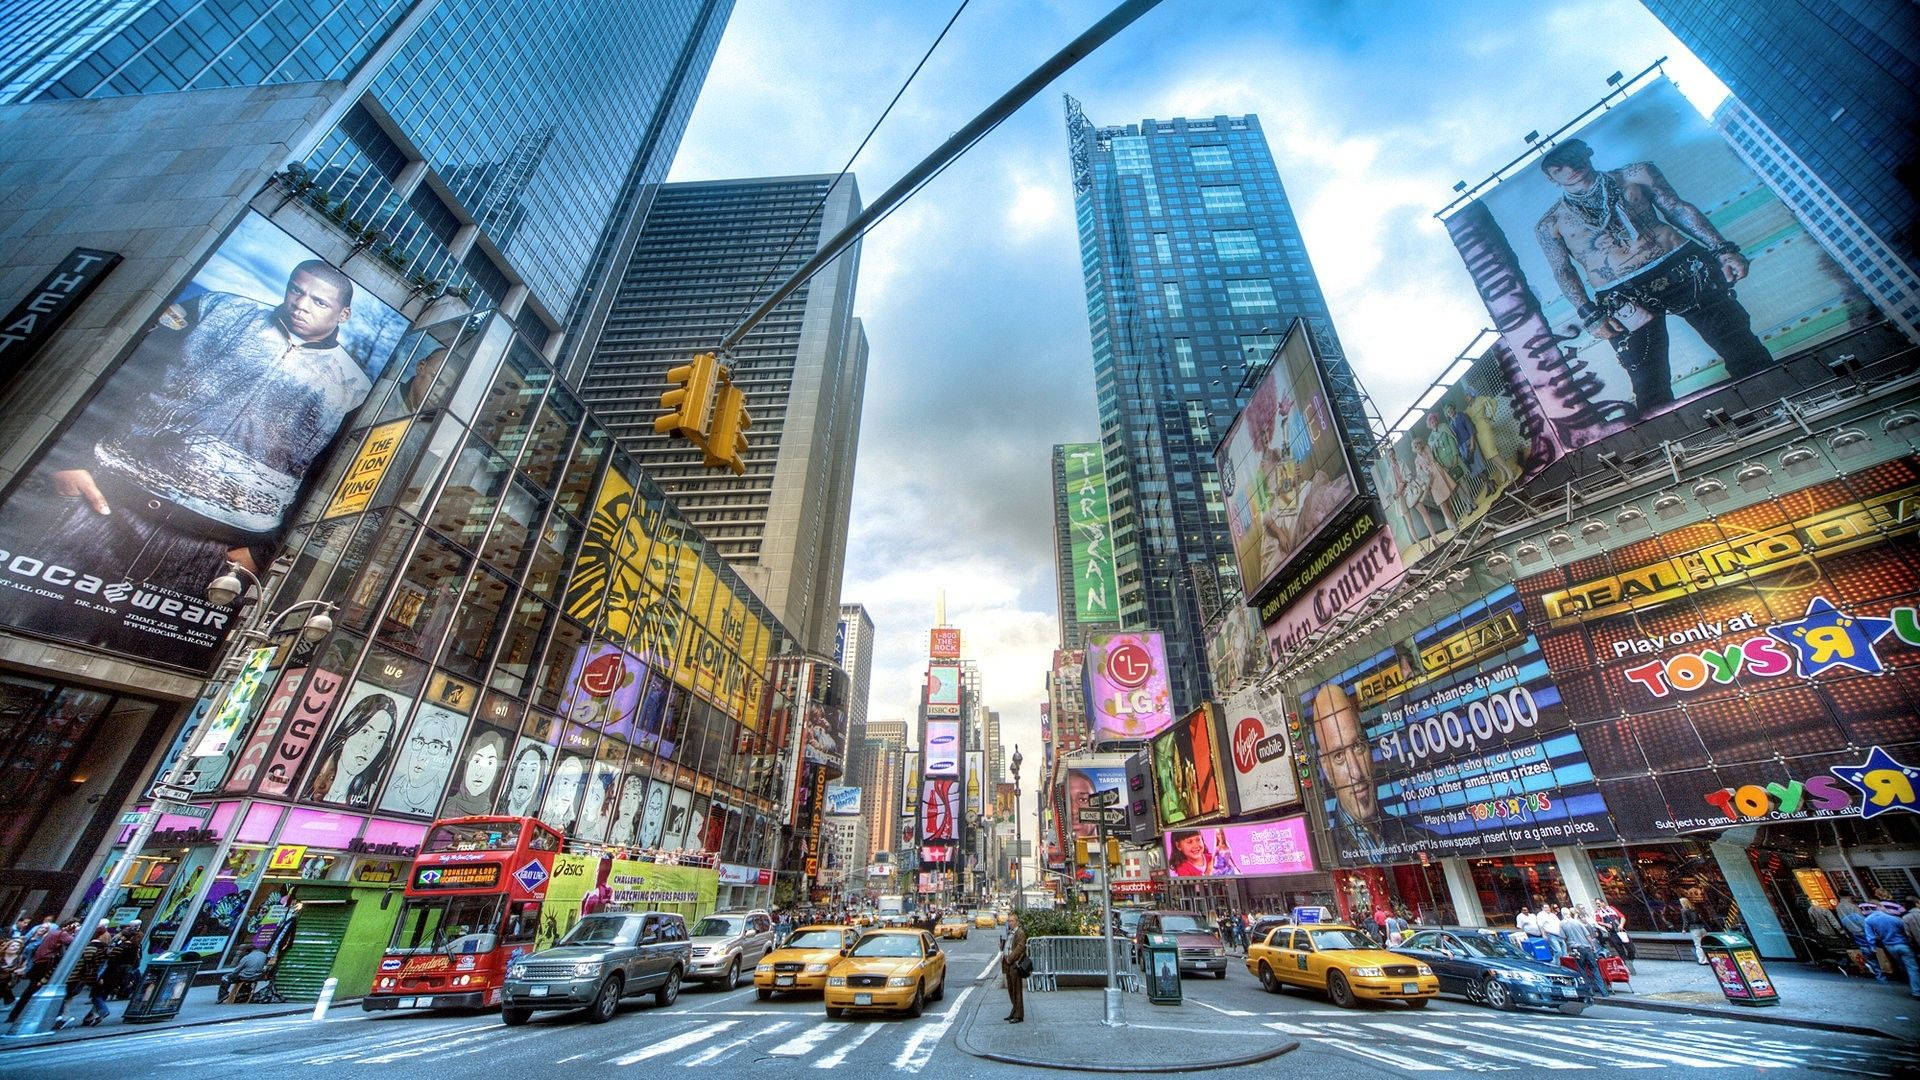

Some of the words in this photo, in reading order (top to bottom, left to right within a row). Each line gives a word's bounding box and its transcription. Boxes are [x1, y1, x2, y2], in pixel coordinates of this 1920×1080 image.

[370, 438, 393, 453] THE
[350, 455, 388, 480] LION
[335, 478, 375, 505] KING
[1261, 599, 1279, 621] BORN
[1279, 592, 1288, 604] IN
[1287, 580, 1302, 598] THE
[1301, 535, 1352, 585] GLAMOROUS
[1352, 514, 1374, 540] USA
[1554, 570, 1682, 619] DEAL
[1699, 534, 1803, 574] NO
[11, 582, 33, 593] ALL
[35, 587, 65, 601] ODDS
[142, 582, 157, 592] WE
[159, 587, 182, 599] RUN
[184, 594, 203, 605] THE
[203, 599, 234, 613] STRIP
[93, 604, 118, 615] JAYS
[123, 619, 214, 649] WWW.ROCAWEAR.COM
[125, 613, 156, 627] JIMMY
[156, 620, 180, 632] JAZZ
[186, 628, 218, 642] MACY'S
[1612, 634, 1665, 658] Play
[1669, 621, 1723, 648] only
[1728, 611, 1758, 634] at
[384, 664, 403, 679] we
[1624, 637, 1792, 698] TOYS
[1114, 691, 1153, 714] LG
[1382, 708, 1403, 724] Play
[1404, 703, 1420, 716] for
[1422, 700, 1429, 709] a
[1431, 683, 1474, 706] chance
[1476, 676, 1490, 688] to
[1492, 664, 1520, 682] win
[495, 704, 507, 718] all
[268, 676, 336, 785] PEACE
[1379, 686, 1539, 768] $1,000,000
[1236, 724, 1259, 768] Virgin
[1259, 738, 1283, 759] mobile
[1400, 778, 1408, 787] or
[1417, 769, 1432, 785] trip
[1434, 766, 1444, 777] to
[1445, 763, 1461, 775] the
[1463, 757, 1495, 772] show,
[1496, 753, 1507, 764] or
[1512, 745, 1536, 759] over
[1401, 785, 1435, 801] 100,000
[1438, 779, 1462, 795] other
[1465, 769, 1509, 788] amazing
[1511, 760, 1551, 779] prizes!
[158, 786, 169, 796] ONE
[173, 790, 187, 799] WAY
[815, 766, 826, 811] KODAK
[1704, 775, 1852, 822] TOYS
[1424, 814, 1441, 826] Play
[1458, 810, 1467, 821] at
[1467, 800, 1505, 822] TOYS
[1525, 793, 1551, 812] US
[1439, 836, 1481, 849] newspaper
[1482, 831, 1508, 844] insert
[1509, 829, 1523, 841] for
[1525, 830, 1532, 839] a
[1533, 826, 1567, 842] game
[1569, 820, 1600, 837] piece.
[1655, 818, 1694, 830] Subject
[1696, 816, 1706, 827] to
[520, 871, 533, 880] GRAY
[533, 871, 545, 880] LINE
[1121, 883, 1146, 891] swatch
[614, 890, 649, 901] WATCHING
[650, 891, 672, 902] OTHERS
[673, 892, 686, 901] PASS
[687, 892, 699, 901] YOU
[399, 955, 450, 979] Broadway
